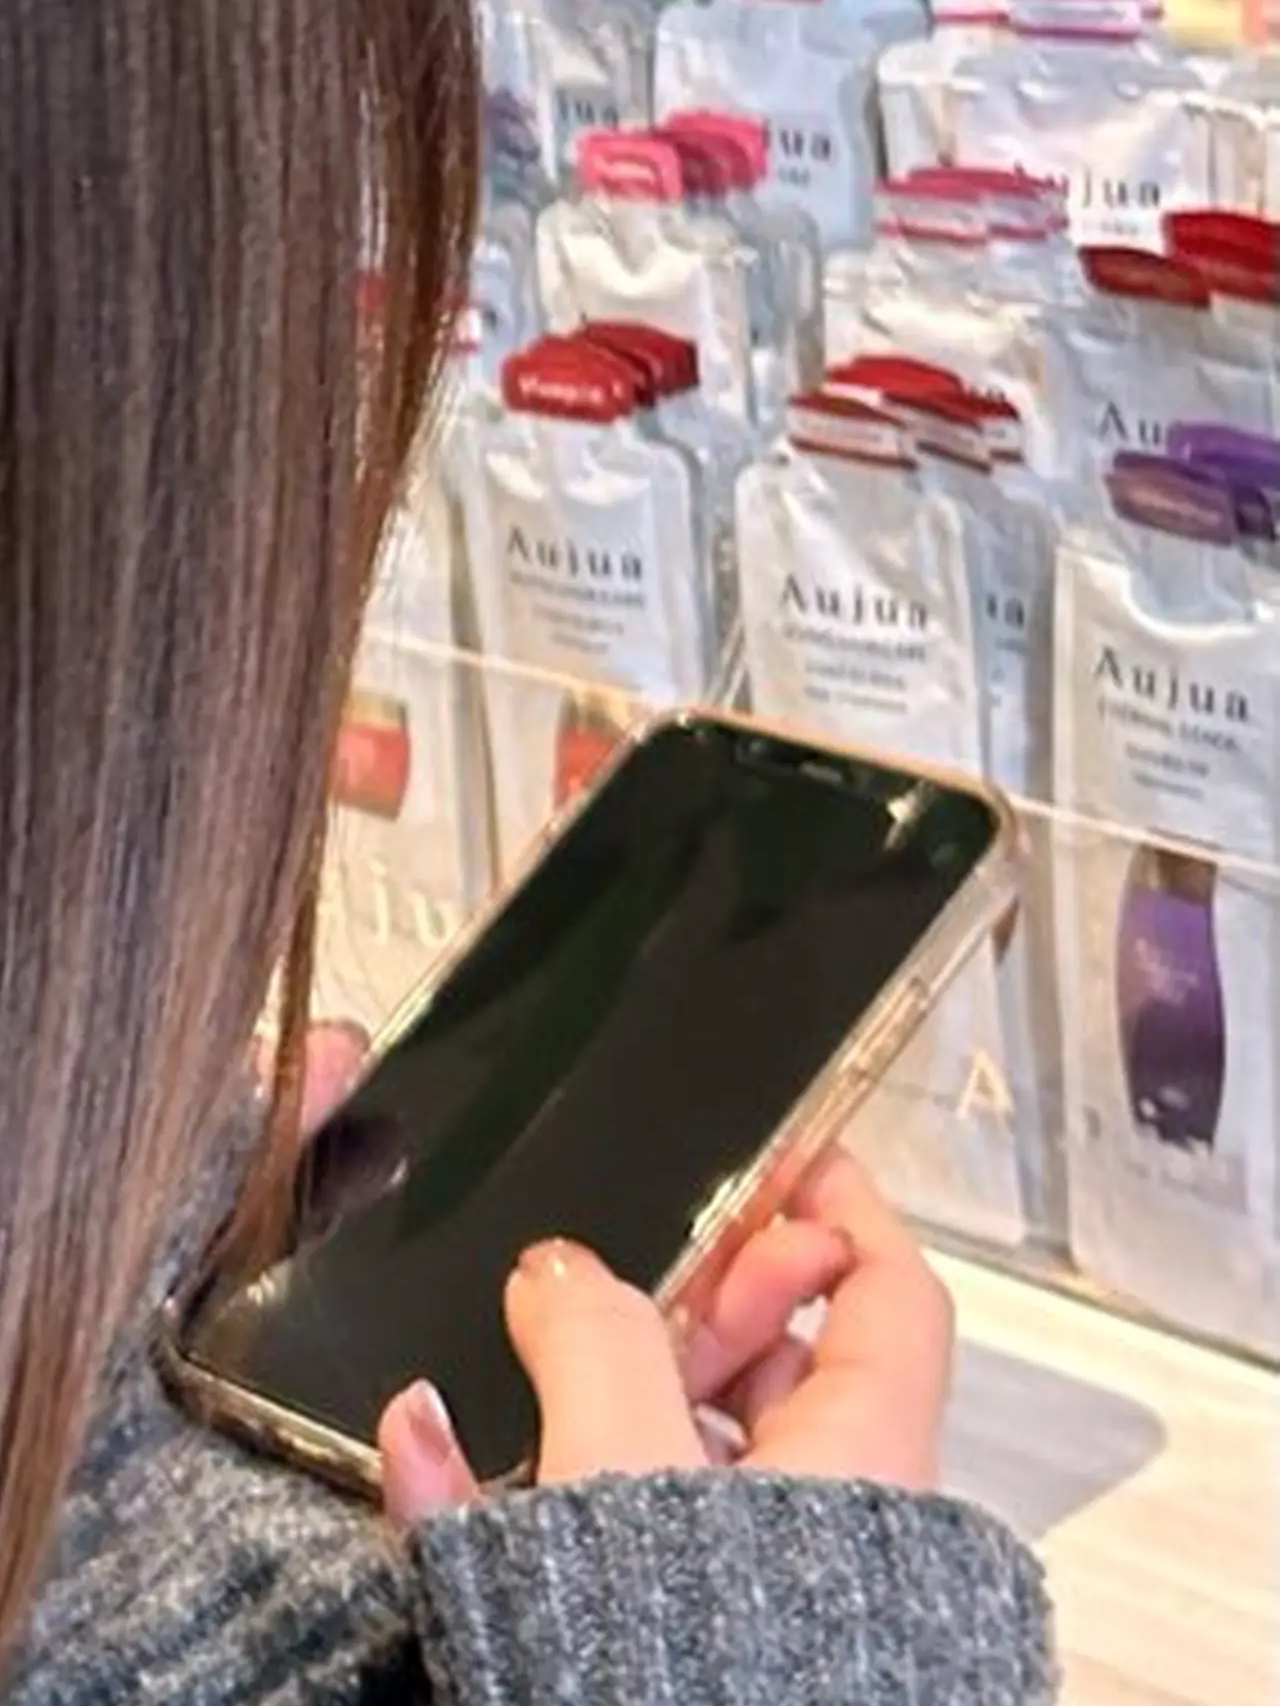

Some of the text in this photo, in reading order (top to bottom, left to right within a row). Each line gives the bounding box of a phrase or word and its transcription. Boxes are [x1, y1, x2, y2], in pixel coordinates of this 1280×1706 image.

[506, 524, 644, 581] Aujua
[781, 573, 928, 631] Aujua
[1093, 646, 1250, 723] Aujua
